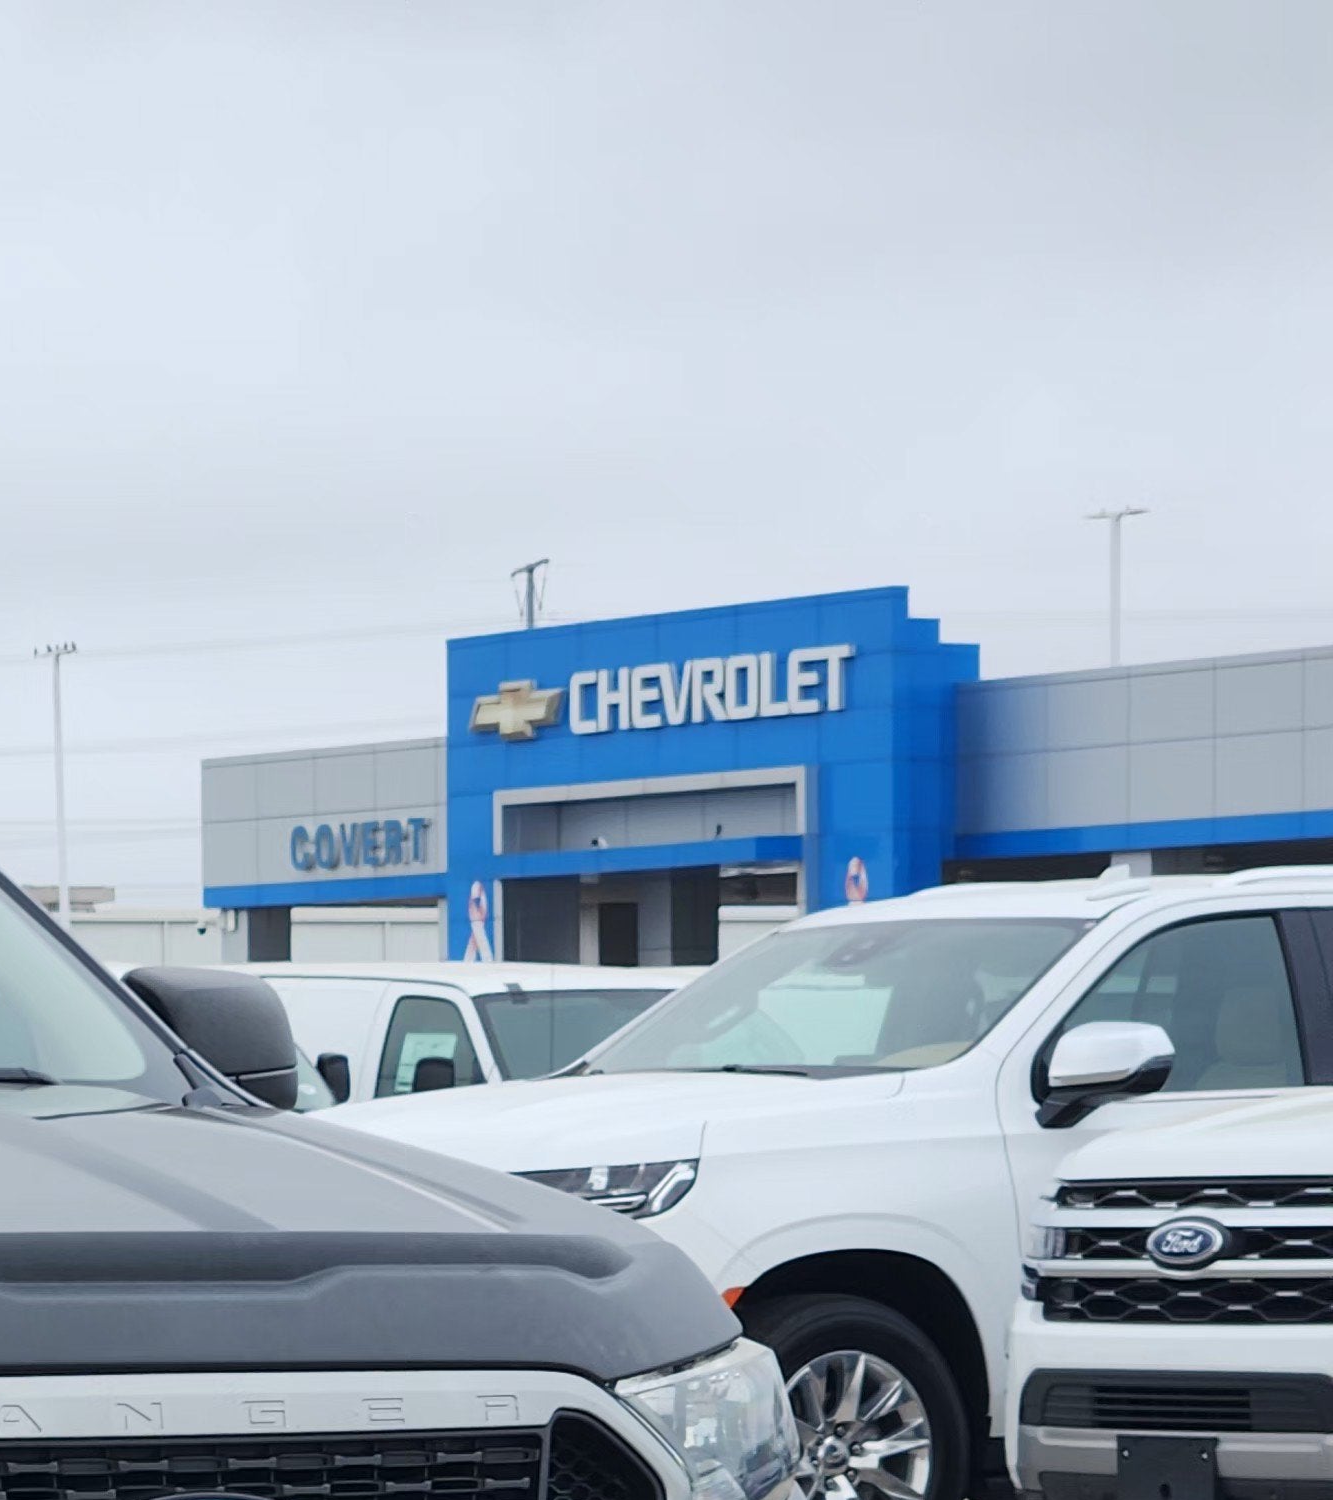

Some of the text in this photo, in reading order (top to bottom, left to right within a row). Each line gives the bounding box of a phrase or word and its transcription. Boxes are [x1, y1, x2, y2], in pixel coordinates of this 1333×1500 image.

[569, 643, 855, 735] CHEVROLET
[290, 817, 431, 871] COVERT
[1161, 1229, 1204, 1253] Ford
